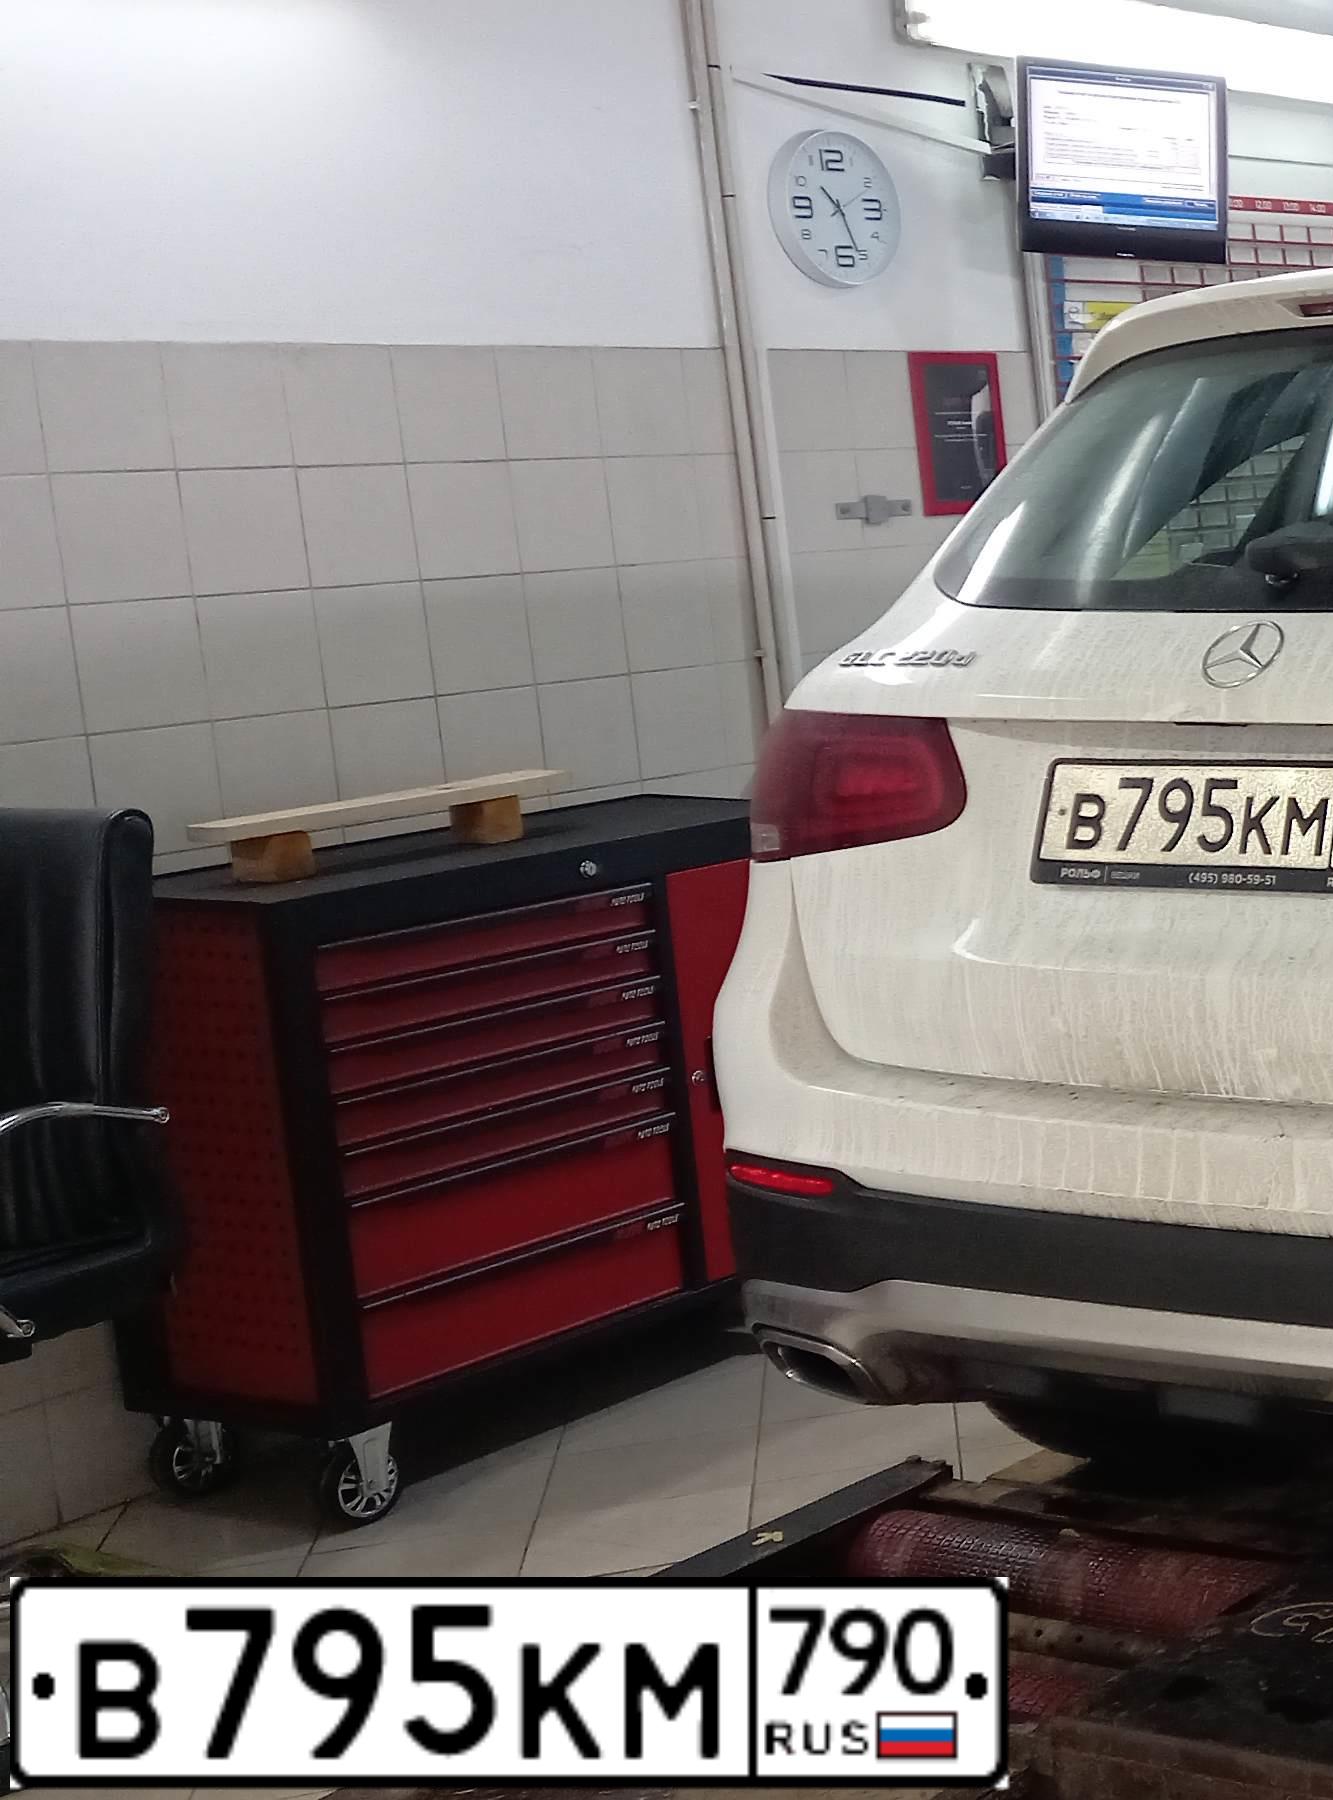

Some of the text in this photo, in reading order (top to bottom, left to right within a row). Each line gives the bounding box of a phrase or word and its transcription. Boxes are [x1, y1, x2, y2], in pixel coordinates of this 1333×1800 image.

[819, 149, 845, 171] 12
[864, 177, 873, 188] 2
[792, 196, 813, 219] 9
[862, 198, 883, 221] 3
[801, 229, 812, 240] 8
[818, 248, 828, 260] 7
[835, 245, 855, 268] 6
[1065, 776, 1331, 857] В795КМ
[1060, 867, 1101, 879] РОЛЬФ
[1188, 872, 1218, 885] (495)
